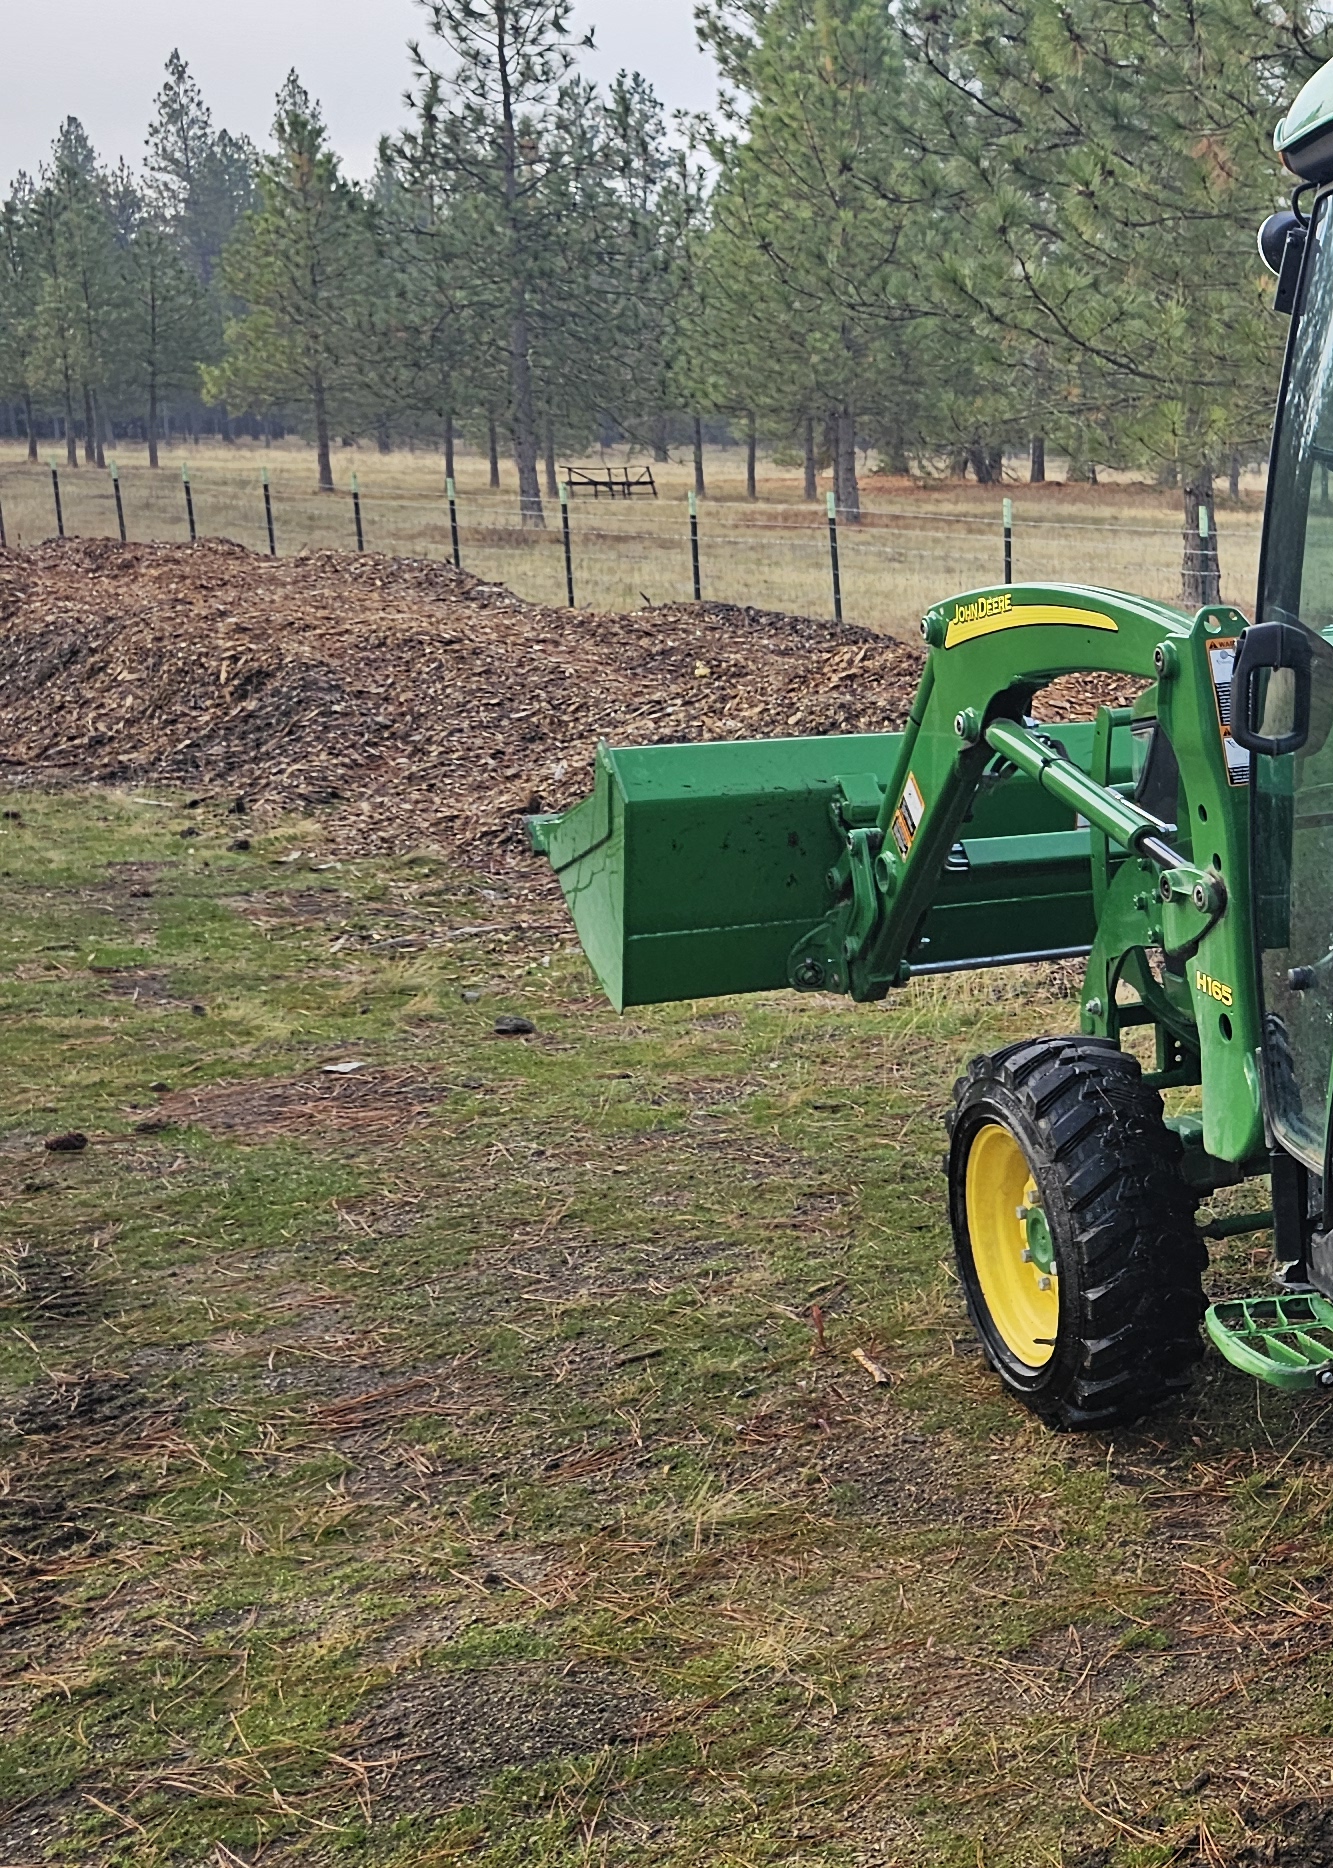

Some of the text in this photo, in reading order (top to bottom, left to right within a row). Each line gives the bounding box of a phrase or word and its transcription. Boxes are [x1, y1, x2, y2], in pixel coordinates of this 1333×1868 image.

[952, 593, 1012, 624] JOHN DEERE
[1195, 970, 1233, 1007] H165
